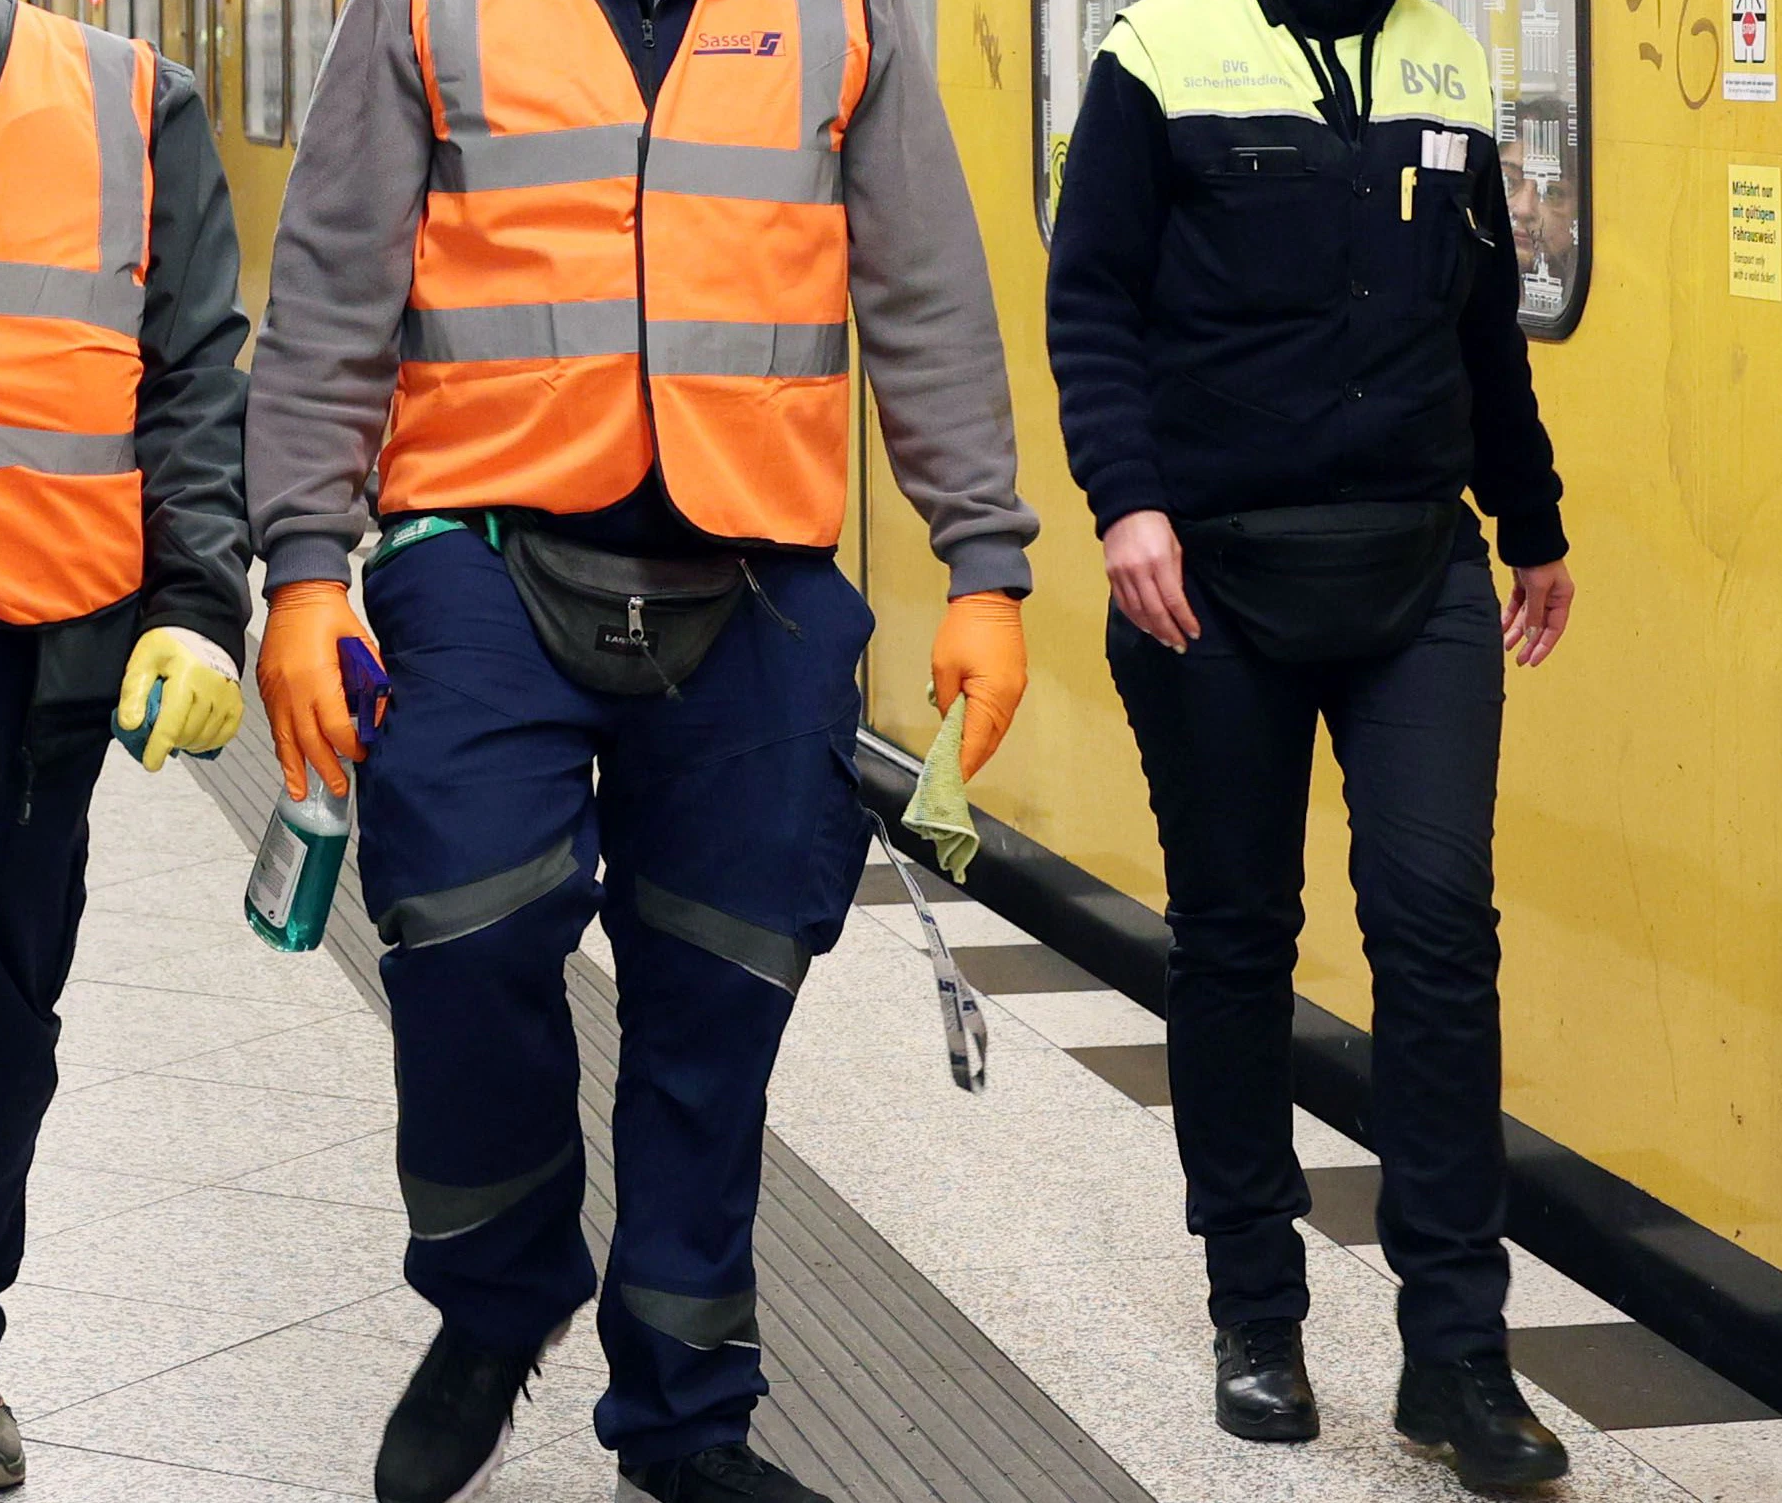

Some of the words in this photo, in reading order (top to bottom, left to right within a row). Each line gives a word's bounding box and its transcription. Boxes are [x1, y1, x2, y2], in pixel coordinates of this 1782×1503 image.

[698, 32, 751, 48] Sasse
[1222, 59, 1249, 74] BVG
[1400, 58, 1467, 100] BVG
[1732, 181, 1760, 197] Mitfahrt
[1761, 186, 1773, 198] nur
[1732, 204, 1744, 218] mit
[1745, 205, 1775, 224] gültigem
[1733, 226, 1776, 244] Fahrausweis!
[1755, 255, 1765, 268] only
